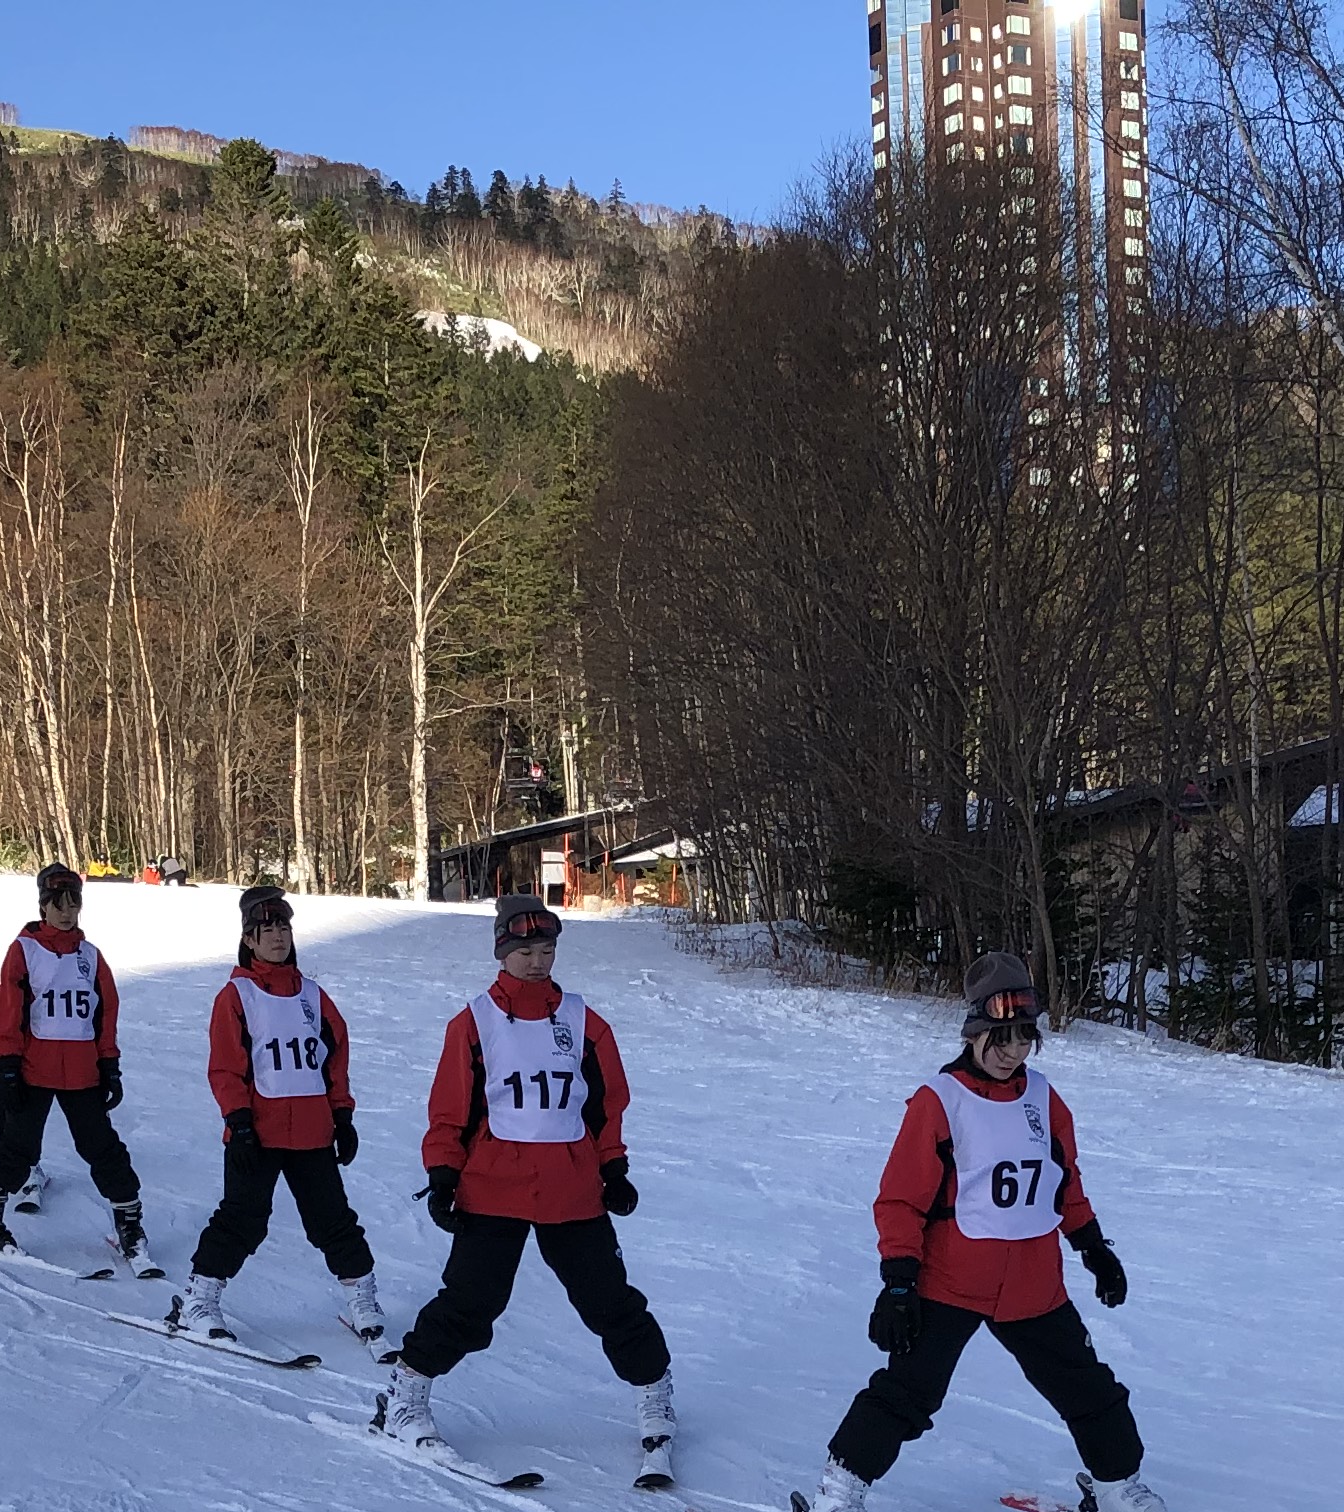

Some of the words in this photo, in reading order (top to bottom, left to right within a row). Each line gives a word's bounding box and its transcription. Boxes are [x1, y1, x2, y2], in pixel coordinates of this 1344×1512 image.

[42, 989, 91, 1019] 115
[265, 1036, 319, 1071] 118
[503, 1070, 574, 1110] 117
[991, 1159, 1043, 1209] 67
